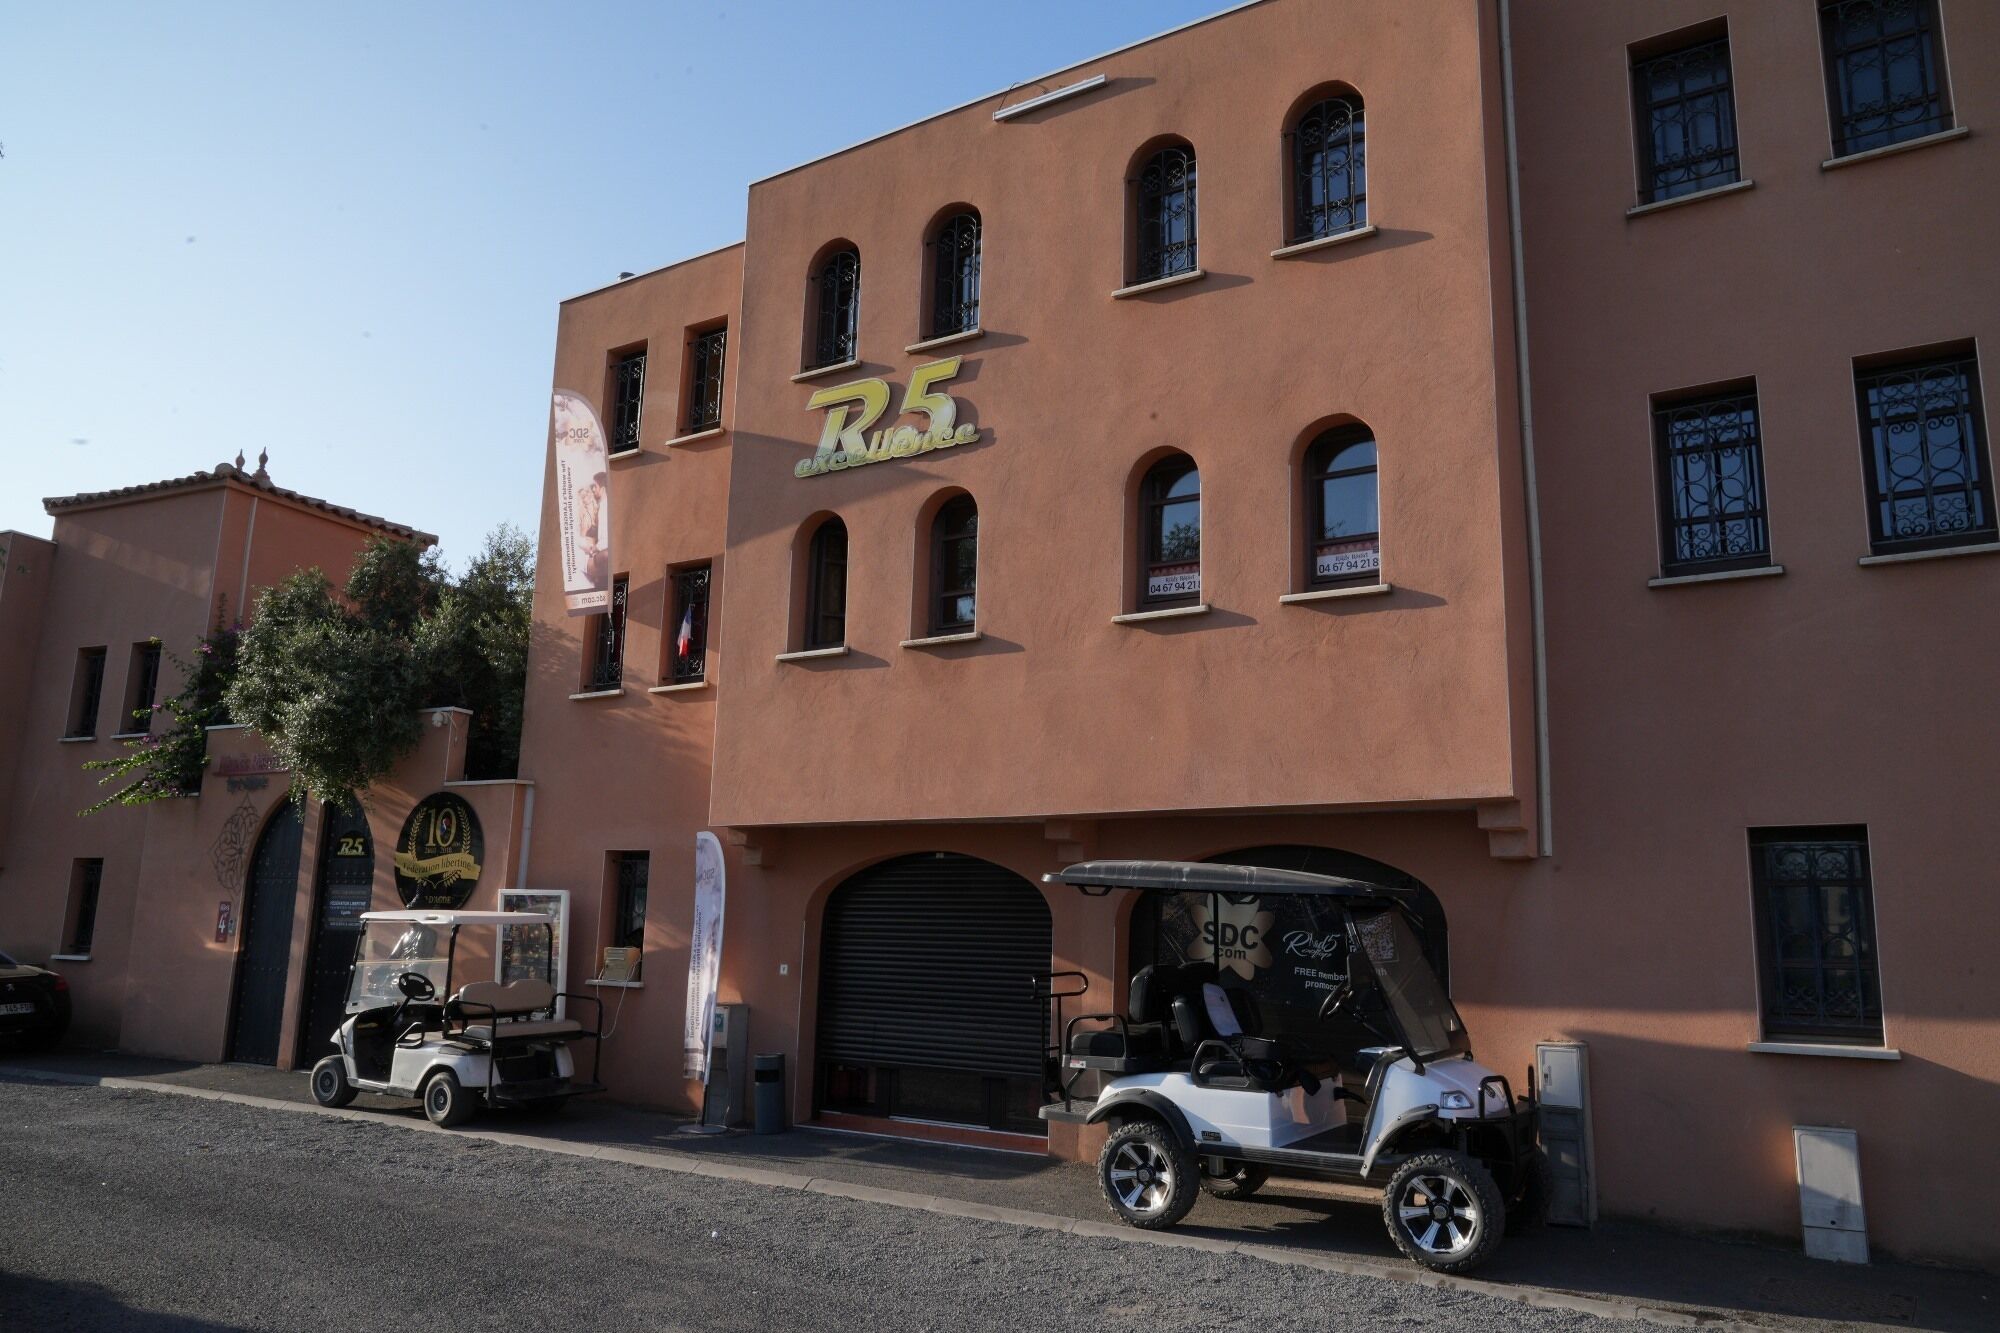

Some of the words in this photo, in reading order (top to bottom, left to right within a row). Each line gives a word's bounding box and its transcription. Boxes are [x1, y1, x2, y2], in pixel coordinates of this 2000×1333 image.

[1319, 564, 1331, 574] 04
[1333, 562, 1345, 571] 67
[1346, 561, 1358, 570] 94
[1360, 559, 1371, 568] 21
[1150, 584, 1161, 594] 04
[1162, 583, 1173, 592] 67
[1175, 582, 1185, 591] 94
[424, 807, 457, 847] 10
[1203, 921, 1259, 950] SDC
[1294, 967, 1317, 977] FREE
[1318, 971, 1348, 981] member
[1305, 980, 1338, 991] promoco
